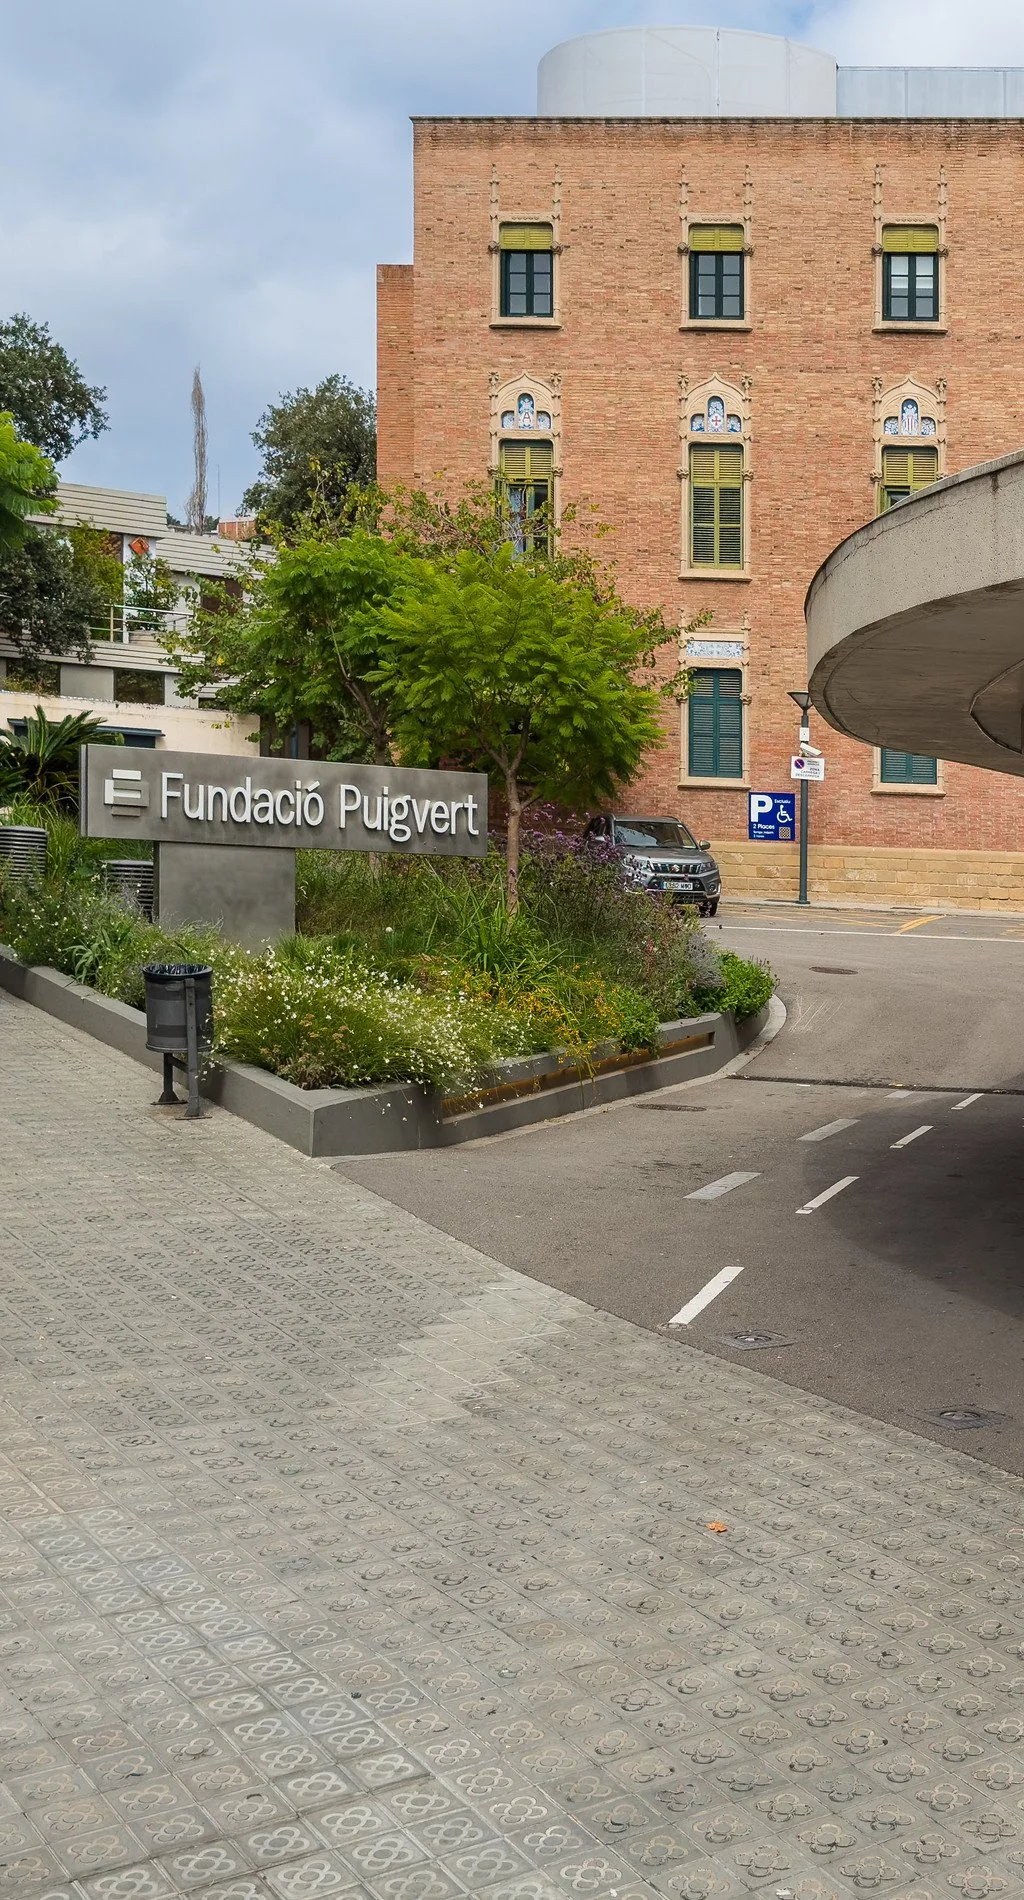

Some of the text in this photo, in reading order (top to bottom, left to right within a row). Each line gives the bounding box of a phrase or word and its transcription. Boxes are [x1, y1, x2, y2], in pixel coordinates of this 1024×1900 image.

[160, 772, 480, 842] Fundació Puigvert
[751, 794, 773, 822] P
